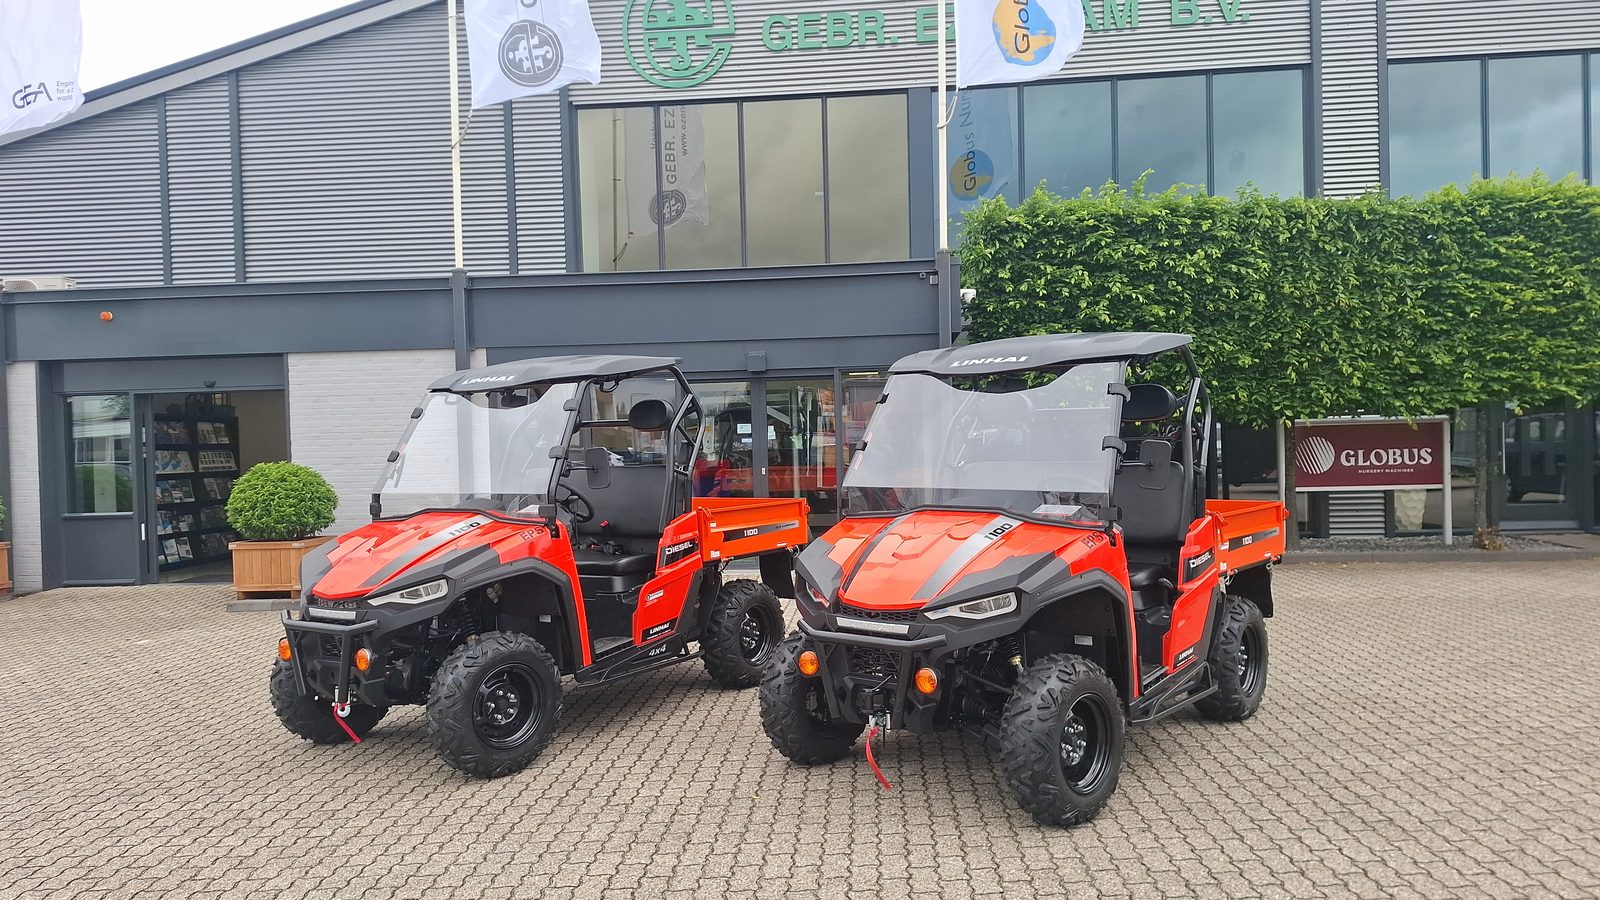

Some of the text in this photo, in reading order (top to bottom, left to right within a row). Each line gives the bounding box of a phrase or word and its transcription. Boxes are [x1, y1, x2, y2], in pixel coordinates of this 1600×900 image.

[1171, 0, 1251, 25] B.V.
[761, 10, 898, 50] GEBR.
[12, 82, 54, 109] GEA
[664, 136, 677, 184] GEBR.
[964, 132, 977, 191] Globus
[949, 356, 1029, 367] LINHAI
[461, 375, 516, 385] LINHAI
[1340, 447, 1433, 467] GLOBUS
[448, 521, 481, 537] 1100
[519, 526, 545, 541] EPS
[743, 528, 758, 537] 1100
[984, 522, 1014, 540] 1100
[665, 541, 694, 555] DIESEL
[1080, 531, 1104, 549] EPS
[1188, 551, 1212, 569] DIESEL
